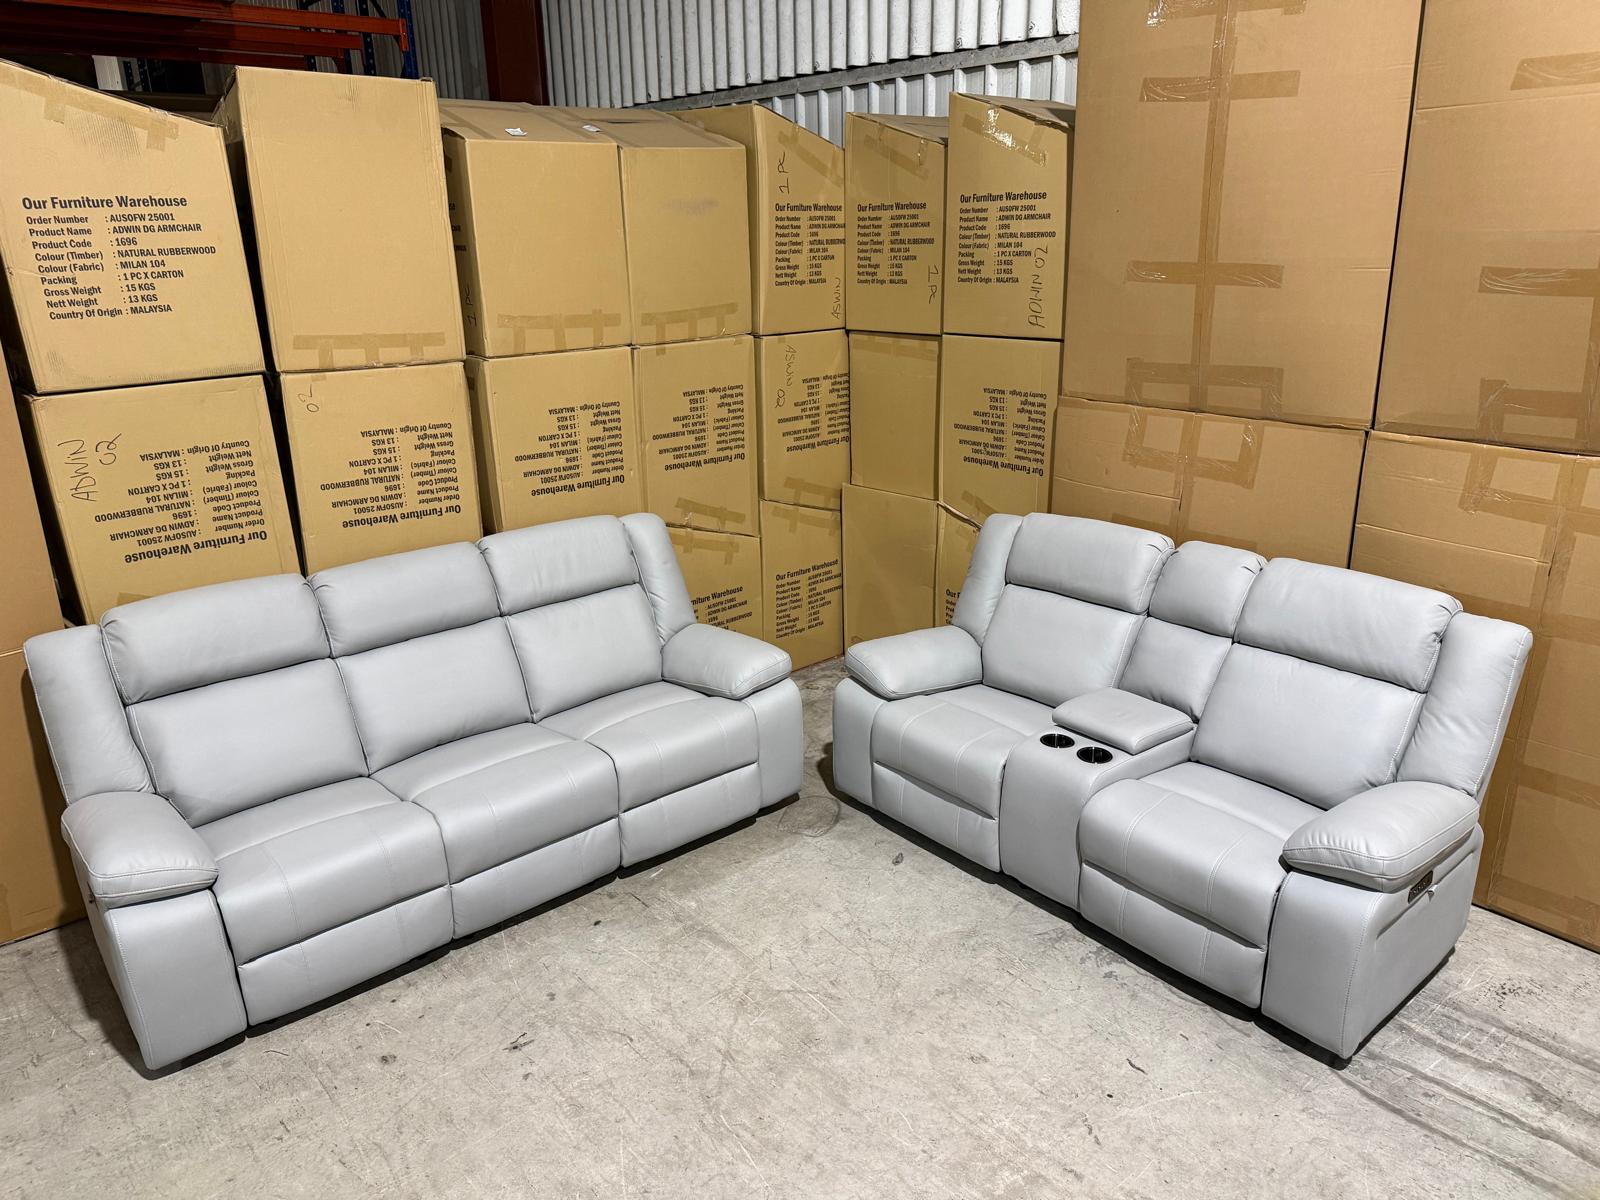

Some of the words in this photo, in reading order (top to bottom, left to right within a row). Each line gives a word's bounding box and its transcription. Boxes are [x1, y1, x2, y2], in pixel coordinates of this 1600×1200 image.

[960, 194, 972, 203] Our
[973, 192, 1004, 203] Furniture
[1005, 190, 1046, 201] Warehouse
[22, 197, 47, 209] Our
[50, 196, 113, 209] Furniture
[115, 195, 187, 208] Warehouse
[857, 203, 868, 212] Our
[868, 202, 894, 211] Furniture
[894, 201, 927, 210] Warehouse
[775, 203, 786, 211] Our
[787, 203, 812, 212] Furniture
[813, 203, 843, 212] Warehouse
[26, 216, 52, 225] Order
[53, 215, 88, 224] Number
[110, 213, 146, 222] AUSOFW
[147, 213, 175, 221] 25001
[1015, 213, 1023, 221] DG
[1023, 212, 1050, 220] ARMCHAIR
[28, 227, 65, 237] Product
[66, 227, 92, 235] Name
[112, 225, 141, 234] ADWIN
[142, 224, 156, 233] DG
[157, 223, 202, 233] ARMCHAIR
[1020, 231, 1055, 239] RUBBERWOOD
[31, 240, 68, 249] Product
[69, 239, 92, 248] Code
[115, 237, 137, 246] 1696
[35, 253, 64, 261] Colour
[66, 251, 103, 261] (Timber)
[117, 248, 156, 258] NATURAL
[157, 246, 216, 256] RUBBERWOOD
[1034, 245, 1049, 269] 02
[38, 264, 67, 273] Colour
[69, 262, 104, 273] (Fabric)
[119, 260, 148, 269] MILAN
[149, 259, 166, 268] 104
[41, 276, 78, 285] Packing
[130, 272, 142, 280] PC
[143, 271, 149, 279] X
[150, 270, 184, 279] CARTON
[44, 288, 70, 297] Gross
[70, 286, 102, 296] Weight
[125, 284, 137, 292] 15
[138, 282, 156, 291] KGS
[46, 300, 67, 308] Nett
[66, 298, 98, 308] Weight
[128, 295, 139, 303] 13
[140, 294, 158, 302] KGS
[49, 311, 84, 320] Country
[85, 309, 95, 317] Of
[97, 308, 123, 317] Origin
[130, 304, 172, 314] MALAYSIA
[816, 437, 839, 447] Furniture
[840, 435, 849, 443] Our
[211, 444, 220, 452] Of
[221, 440, 250, 449] Country
[786, 442, 816, 452] Warehouse
[187, 445, 210, 455] Origin
[235, 450, 252, 458] Nett
[554, 447, 578, 456] NATURAL
[139, 450, 180, 462] MALAYSIA
[208, 453, 235, 462] Weight
[515, 451, 554, 462] RUBBERWOOD
[703, 454, 732, 465] Furniture
[733, 452, 745, 460] Our
[153, 461, 170, 471] KGS
[171, 460, 182, 468] 13
[232, 460, 254, 468] Gross
[665, 459, 702, 471] Warehouse
[964, 456, 999, 469] Warehouse
[205, 463, 232, 473] Weight
[363, 468, 376, 476] 104
[1000, 462, 1030, 474] Furniture
[1031, 467, 1044, 476] Our
[155, 472, 172, 481] KGS
[173, 470, 184, 478] 15
[225, 470, 256, 480] Packing
[370, 474, 400, 484] NATURAL
[612, 475, 625, 483] Our
[161, 483, 168, 491] X
[168, 481, 180, 490] PC
[202, 482, 232, 494] (Fabric)
[234, 480, 257, 488] Colour
[320, 478, 369, 491] RUBBERWOOD
[576, 477, 611, 489] Furniture
[127, 484, 160, 496] CARTON
[236, 489, 259, 498] Colour
[435, 485, 459, 494] Product
[531, 483, 575, 496] Warehouse
[146, 494, 161, 503] 104
[163, 490, 189, 501] MILAN
[203, 492, 234, 504] (Timber)
[369, 495, 379, 503] DG
[380, 492, 402, 502] ADWIN
[418, 496, 442, 504] Number
[154, 500, 191, 512] NATURAL
[232, 499, 261, 510] Product
[331, 497, 368, 508] ARMCHAIR
[213, 504, 232, 513] Code
[353, 505, 375, 515] 25001
[400, 507, 443, 520] Furniture
[445, 504, 461, 514] Our
[94, 506, 154, 522] RUBBERWOOD
[172, 510, 192, 520] 1696
[212, 514, 234, 522] Name
[234, 509, 263, 520] Product
[168, 520, 195, 531] ADWIN
[244, 518, 265, 527] Order
[342, 514, 398, 528] Warehouse
[155, 525, 167, 533] DG
[215, 522, 244, 532] Number
[109, 527, 154, 541] ARMCHAIR
[164, 530, 197, 542] AUSOFW
[247, 530, 267, 540] Our
[137, 536, 163, 547] 25001
[193, 534, 245, 550] Furniture
[125, 544, 192, 562] Warehouse
[787, 567, 811, 578] Furniture
[811, 560, 839, 572] Warehouse
[711, 586, 744, 600] Warehouse
[946, 588, 957, 598] Our
